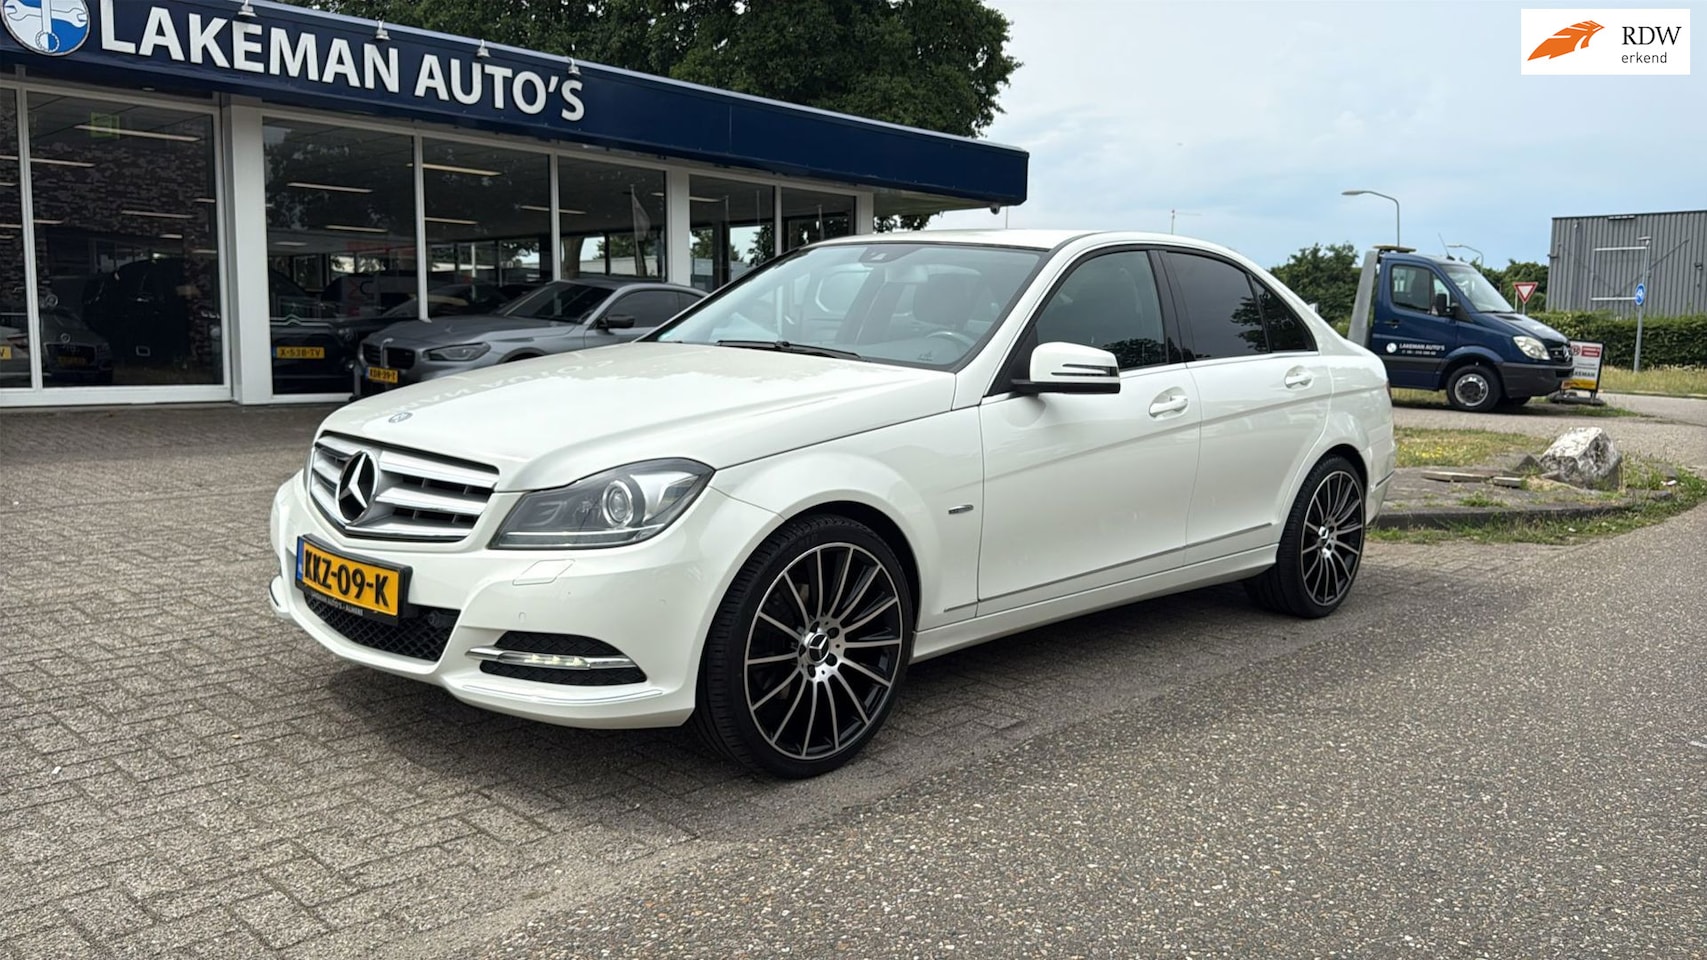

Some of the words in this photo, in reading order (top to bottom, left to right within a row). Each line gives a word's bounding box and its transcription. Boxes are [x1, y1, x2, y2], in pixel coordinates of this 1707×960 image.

[100, 0, 401, 93] LAKEMAN
[414, 54, 585, 121] AUTO'S
[305, 549, 389, 608] KKZ-09-K
